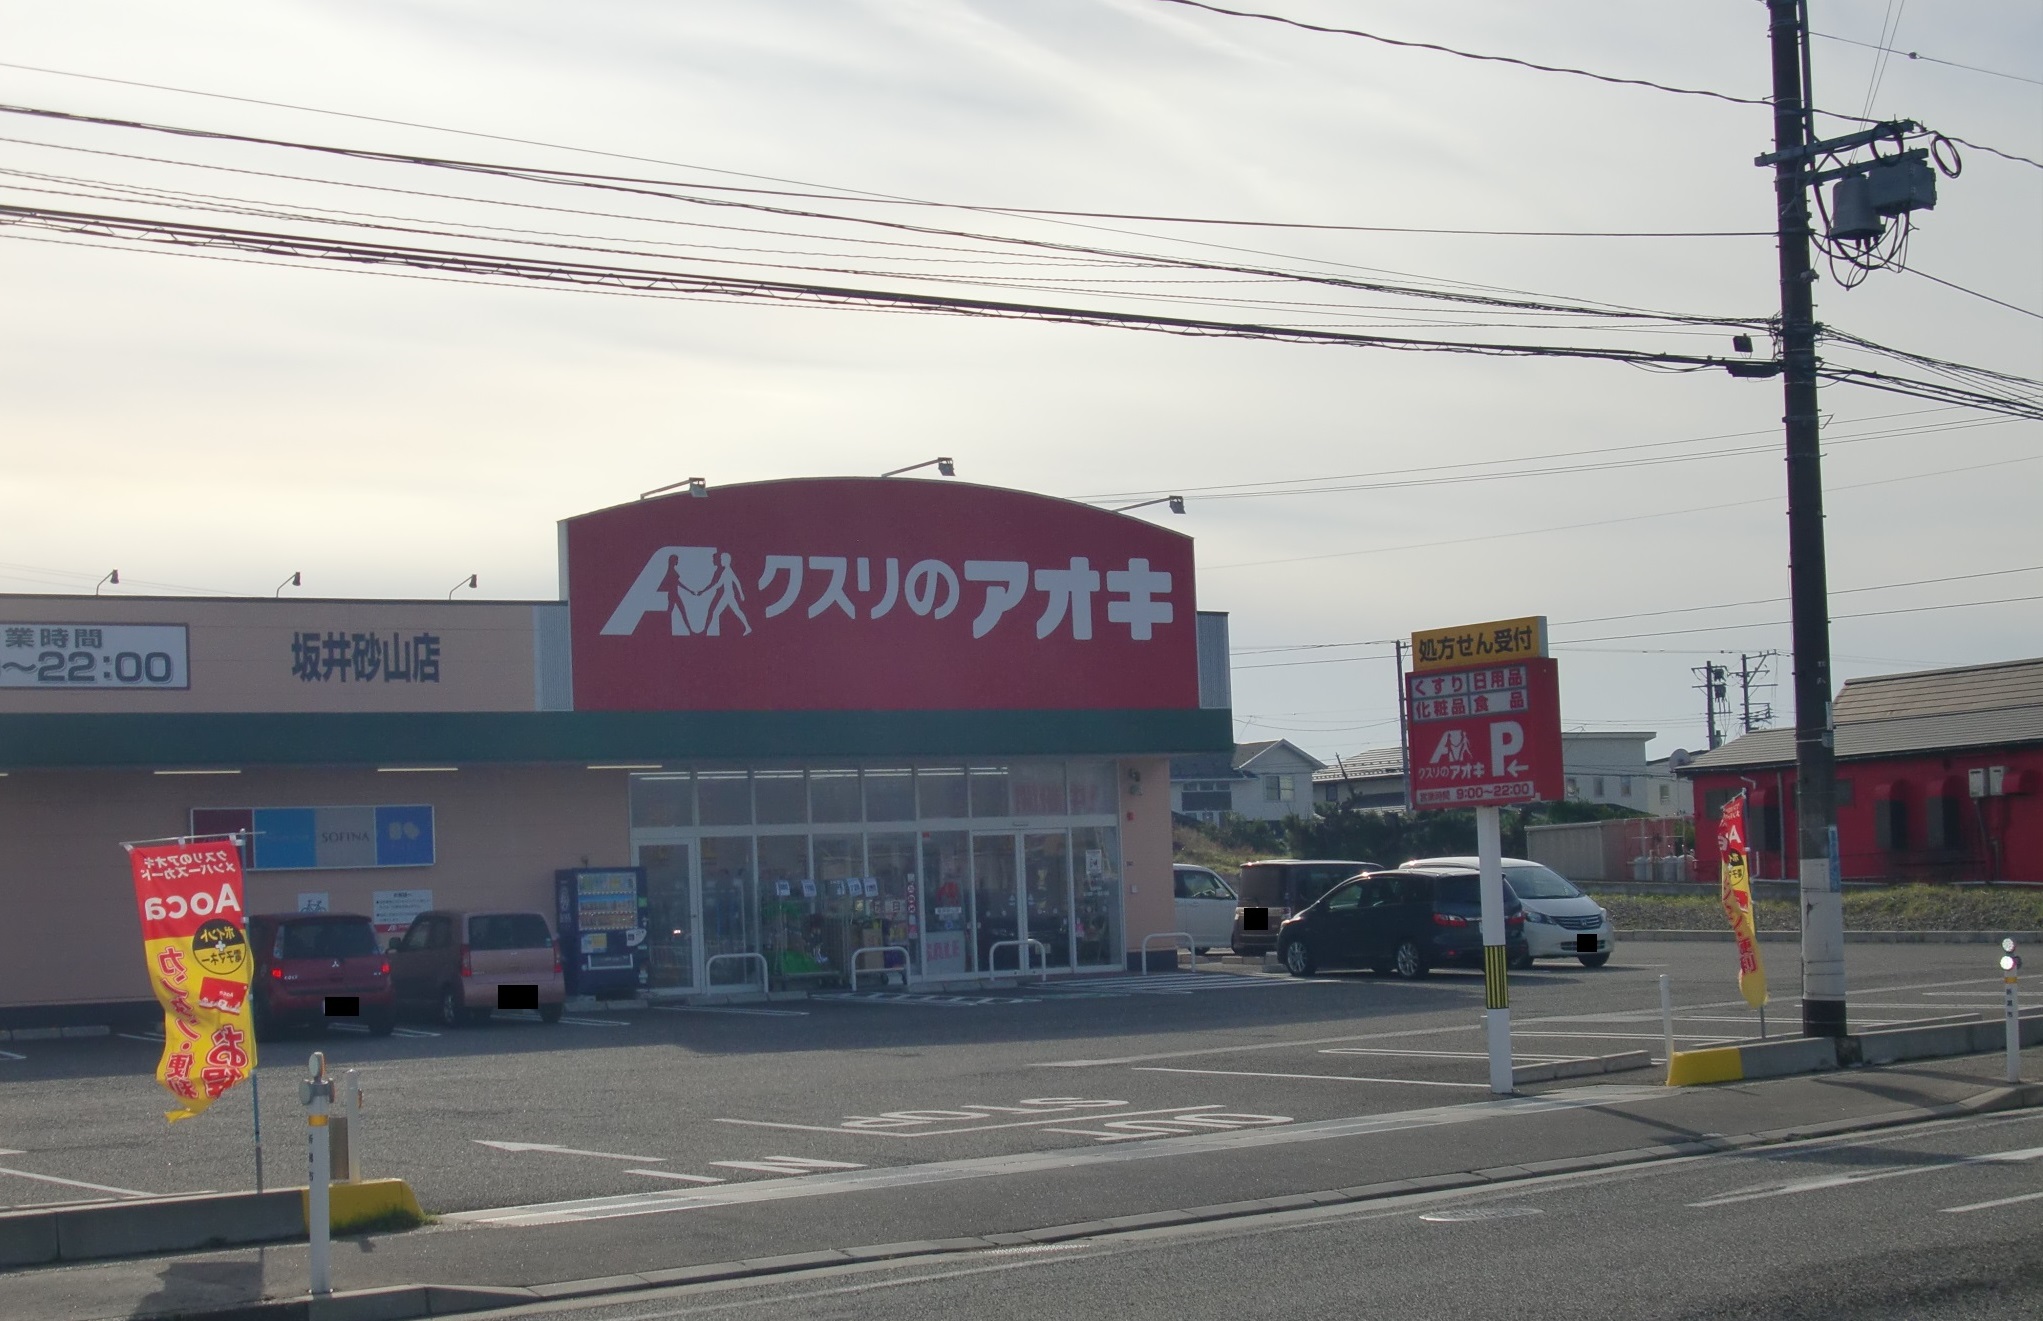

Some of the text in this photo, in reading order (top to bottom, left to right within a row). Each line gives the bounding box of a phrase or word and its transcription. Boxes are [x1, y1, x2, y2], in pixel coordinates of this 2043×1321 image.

[758, 555, 1174, 640] クスリのアオキ
[1419, 625, 1533, 663] 処方せん受付
[291, 631, 441, 684] 坂井砂山店
[1414, 676, 1464, 696] くすり
[1473, 668, 1524, 691] 日用品
[1415, 696, 1466, 719] 化粧品
[1489, 720, 1525, 777] P
[1418, 762, 1486, 780] クスリのアオキ
[321, 831, 370, 843] SOFINA
